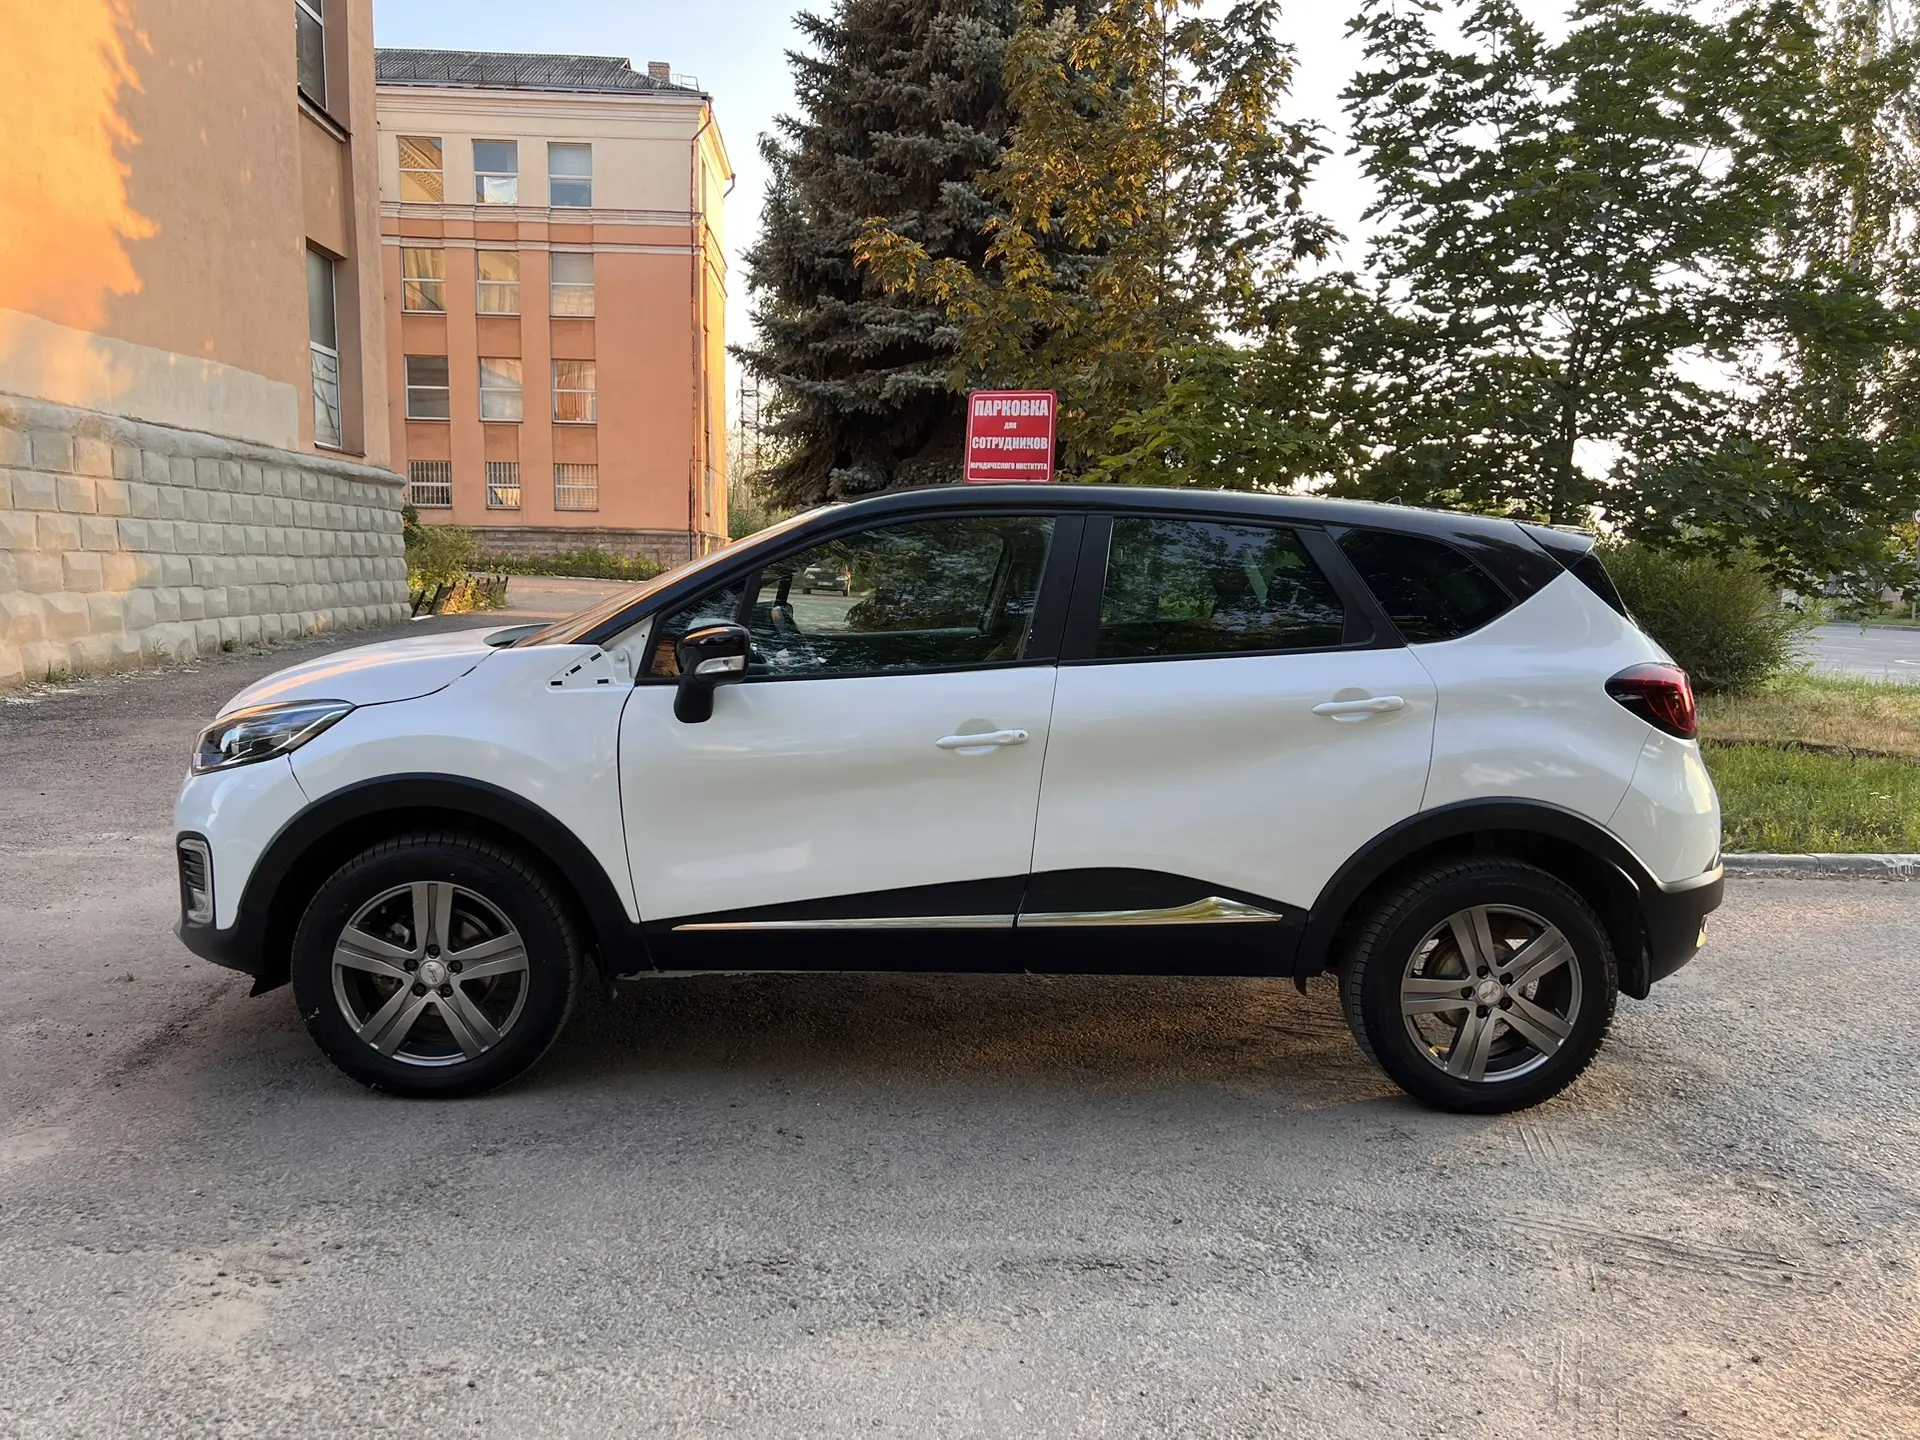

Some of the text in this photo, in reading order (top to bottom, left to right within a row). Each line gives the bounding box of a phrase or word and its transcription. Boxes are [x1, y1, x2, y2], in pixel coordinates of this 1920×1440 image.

[974, 400, 1049, 416] ПАРКОВКА
[971, 437, 1048, 451] СОТРУДНИКОВ
[970, 462, 1048, 471] ЮРИДИЧЕСКОГО ИНСТИТУТА
